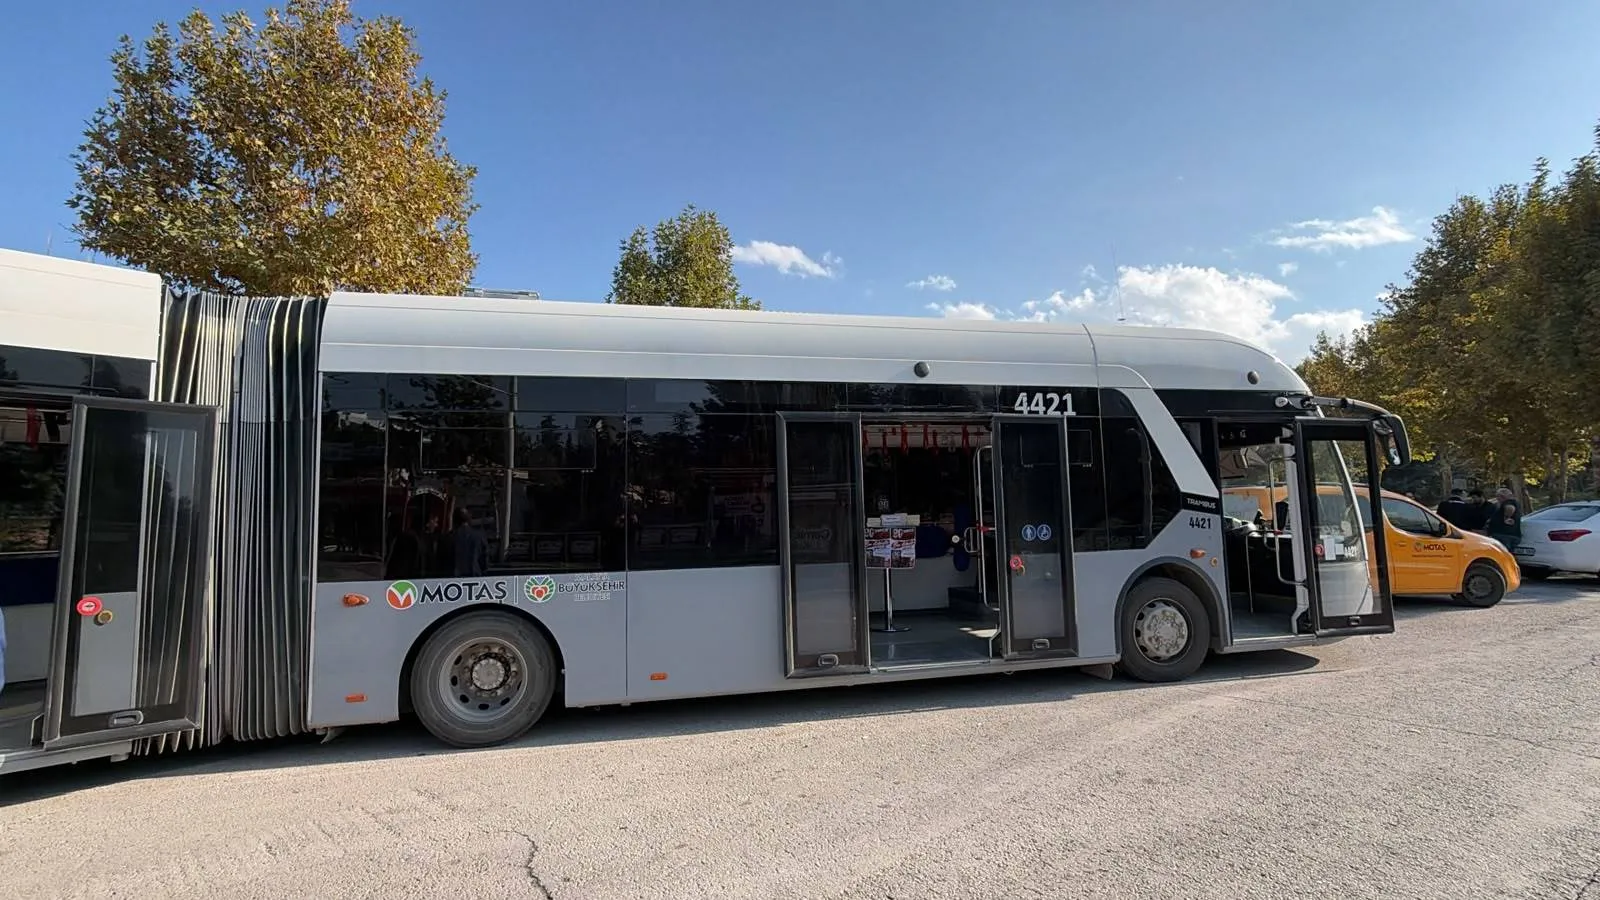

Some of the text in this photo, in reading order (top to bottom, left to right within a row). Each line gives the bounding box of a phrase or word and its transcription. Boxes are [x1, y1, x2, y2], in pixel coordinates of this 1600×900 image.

[1014, 392, 1076, 415] 4421
[1189, 516, 1211, 529] 4421
[420, 580, 508, 605] MOTAŞ
